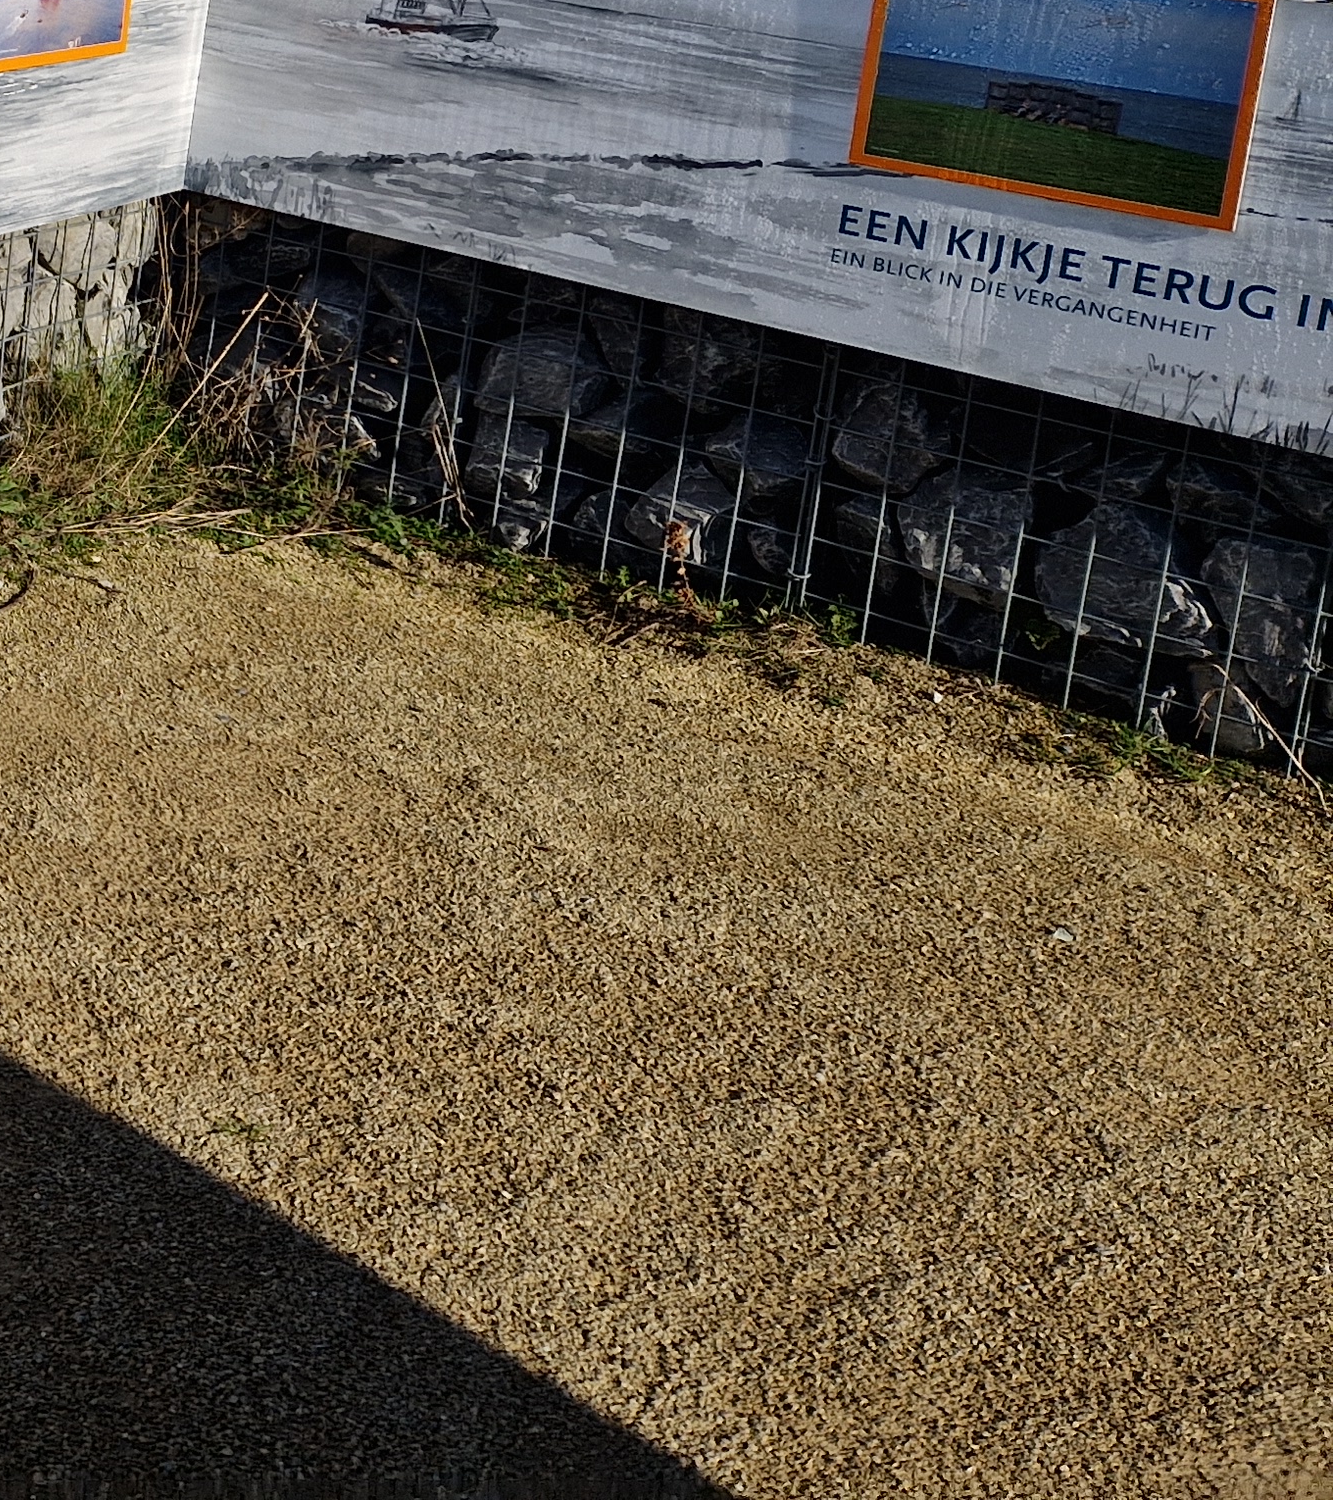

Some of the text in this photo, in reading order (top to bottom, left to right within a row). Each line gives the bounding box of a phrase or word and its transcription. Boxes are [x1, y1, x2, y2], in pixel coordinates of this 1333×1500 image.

[830, 247, 1217, 342] EIN BLICK IN DIE VERGANGENHEIT
[838, 204, 929, 251] EEN
[946, 224, 1087, 285] KIJKJE
[1101, 255, 1278, 321] TERUG
